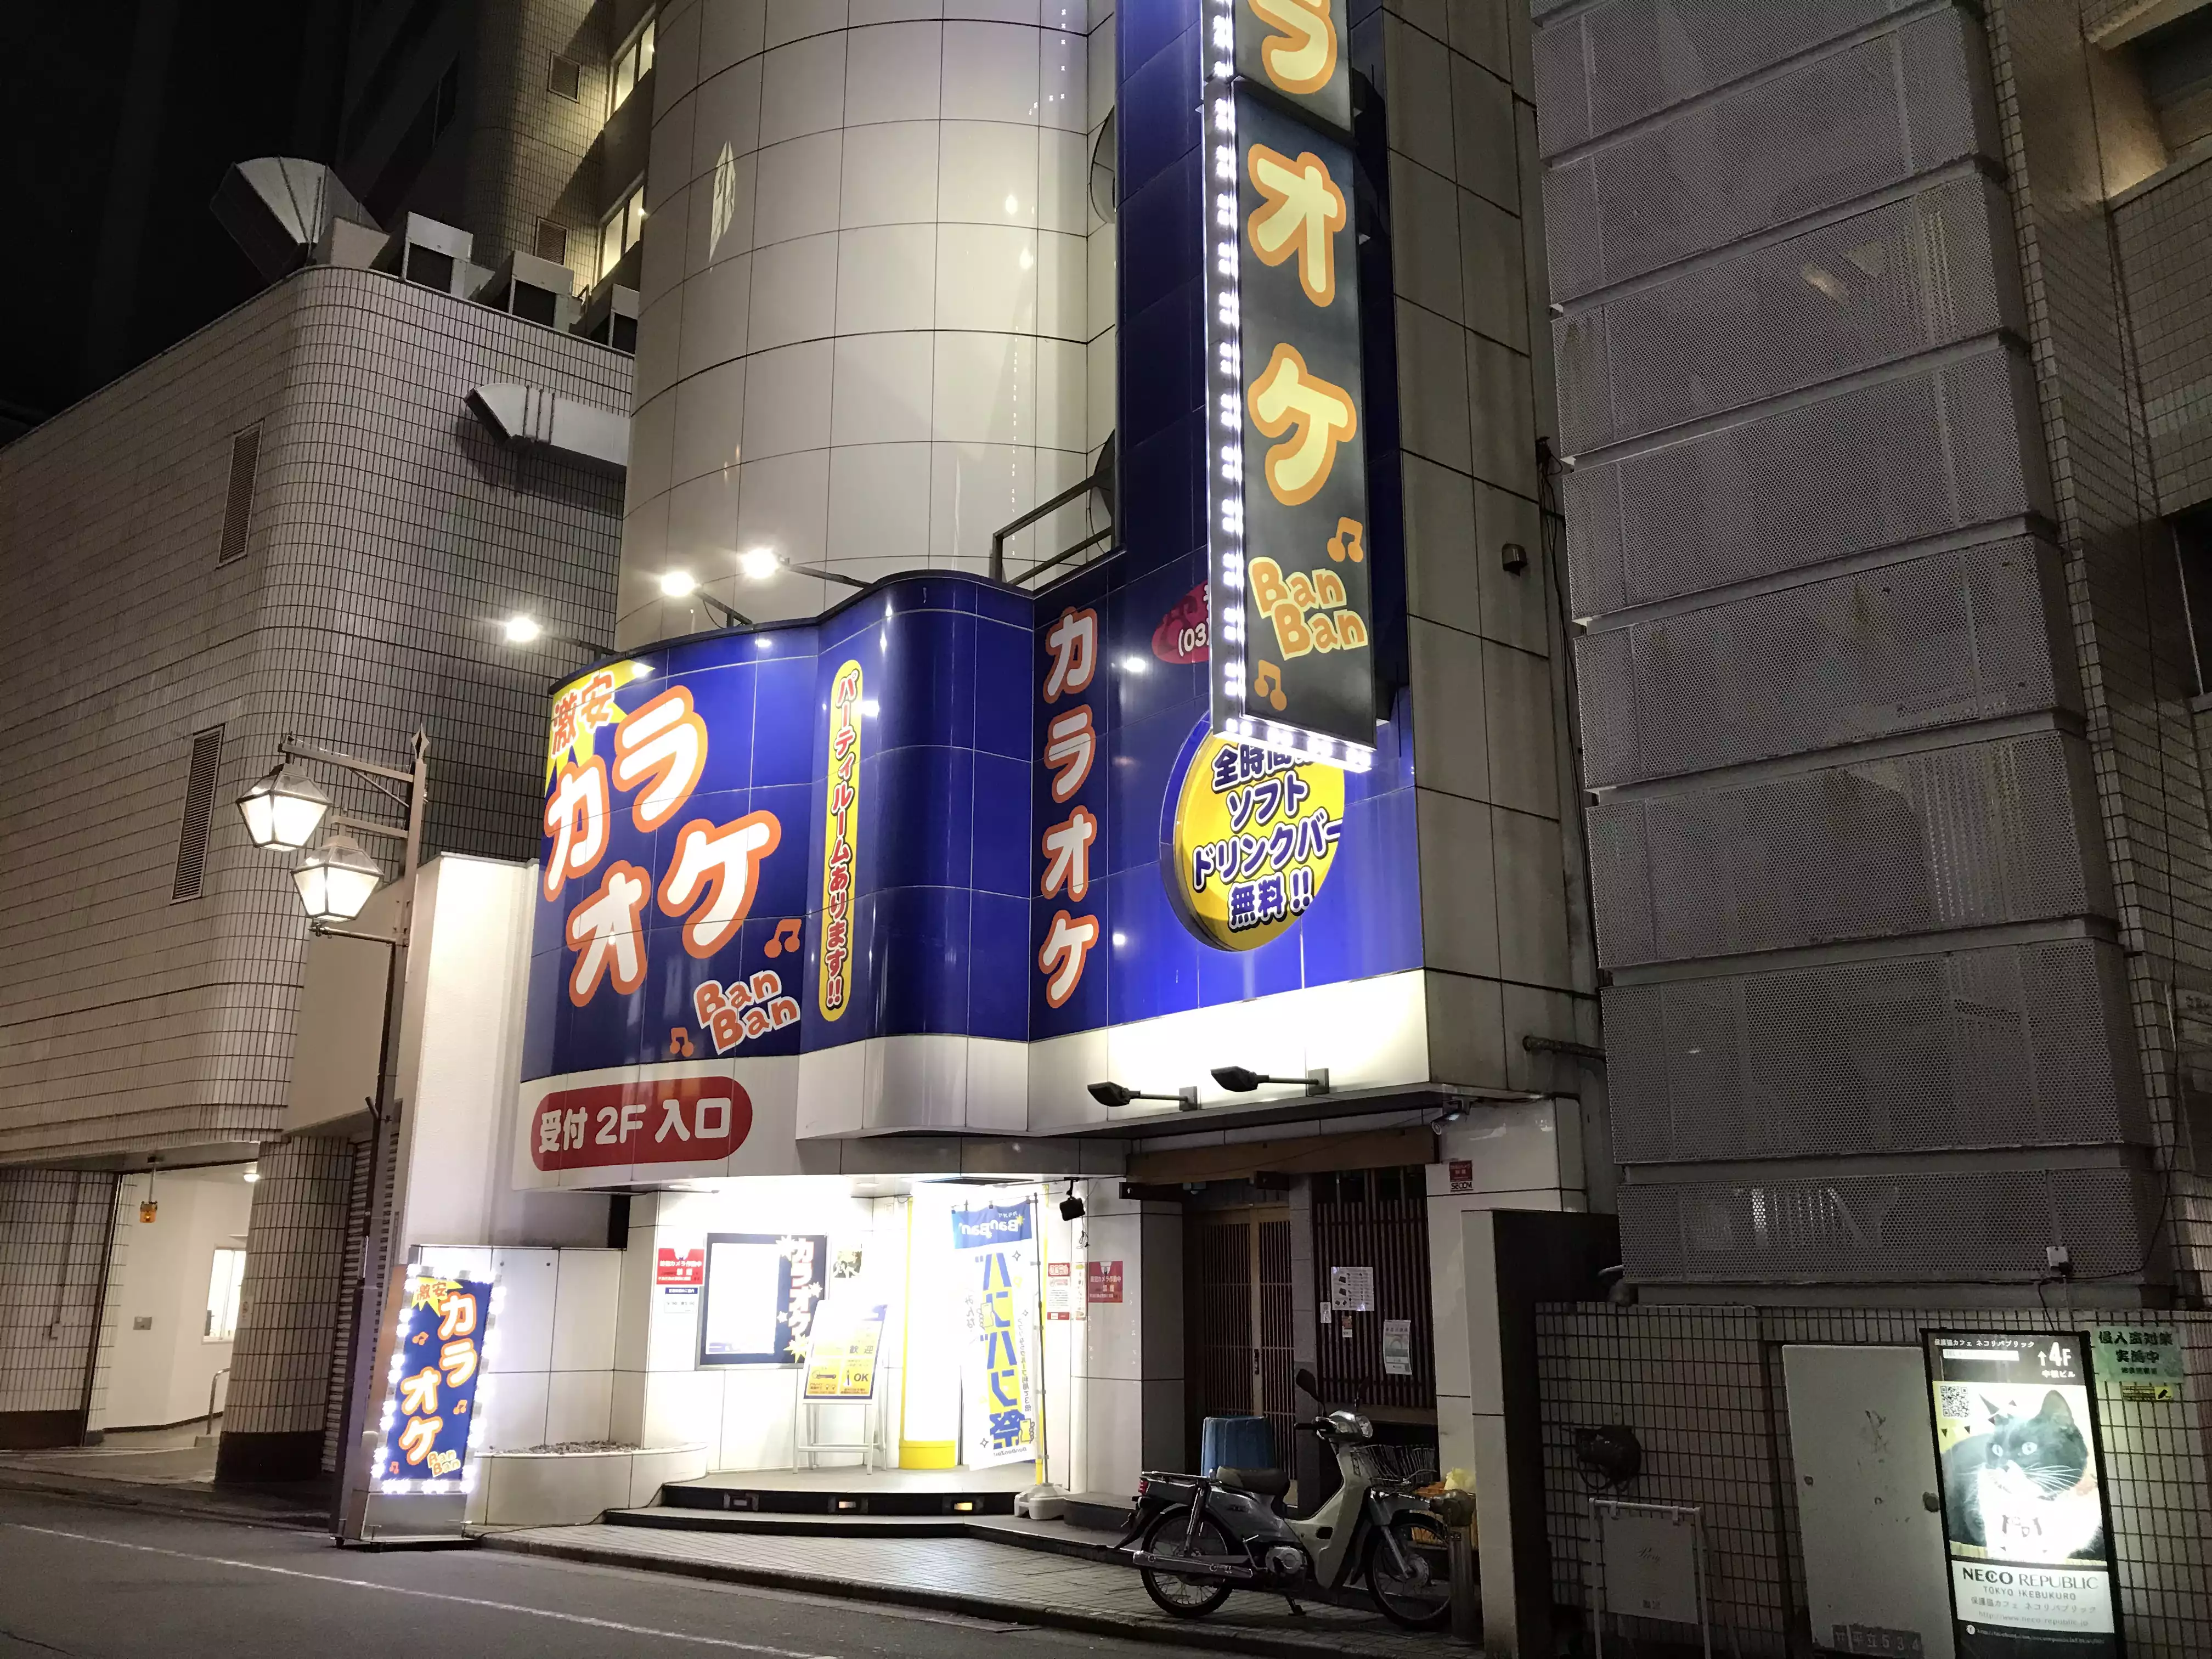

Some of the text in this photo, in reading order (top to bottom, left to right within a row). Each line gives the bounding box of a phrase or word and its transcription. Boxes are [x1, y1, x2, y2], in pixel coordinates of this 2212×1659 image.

[1248, 556, 1347, 619] Ban
[1271, 597, 1369, 661] Ban
[551, 670, 615, 758] 激安
[1211, 742, 1315, 794] 全時間
[1039, 606, 1098, 1008] カラオケ
[1226, 774, 1311, 833] ソフト
[1192, 807, 1342, 892] ドリンクバー
[693, 970, 782, 1030] Ban
[710, 996, 801, 1054] Ban
[539, 1097, 731, 1154] 受付 2F 入口
[416, 1282, 448, 1300] 激安
[854, 1373, 868, 1381] OK
[2049, 1342, 2072, 1366] 4F
[1962, 1567, 2099, 1590] NECO REPUBLIC
[1983, 1587, 2076, 1601] TOKYO IKEBUKURO
